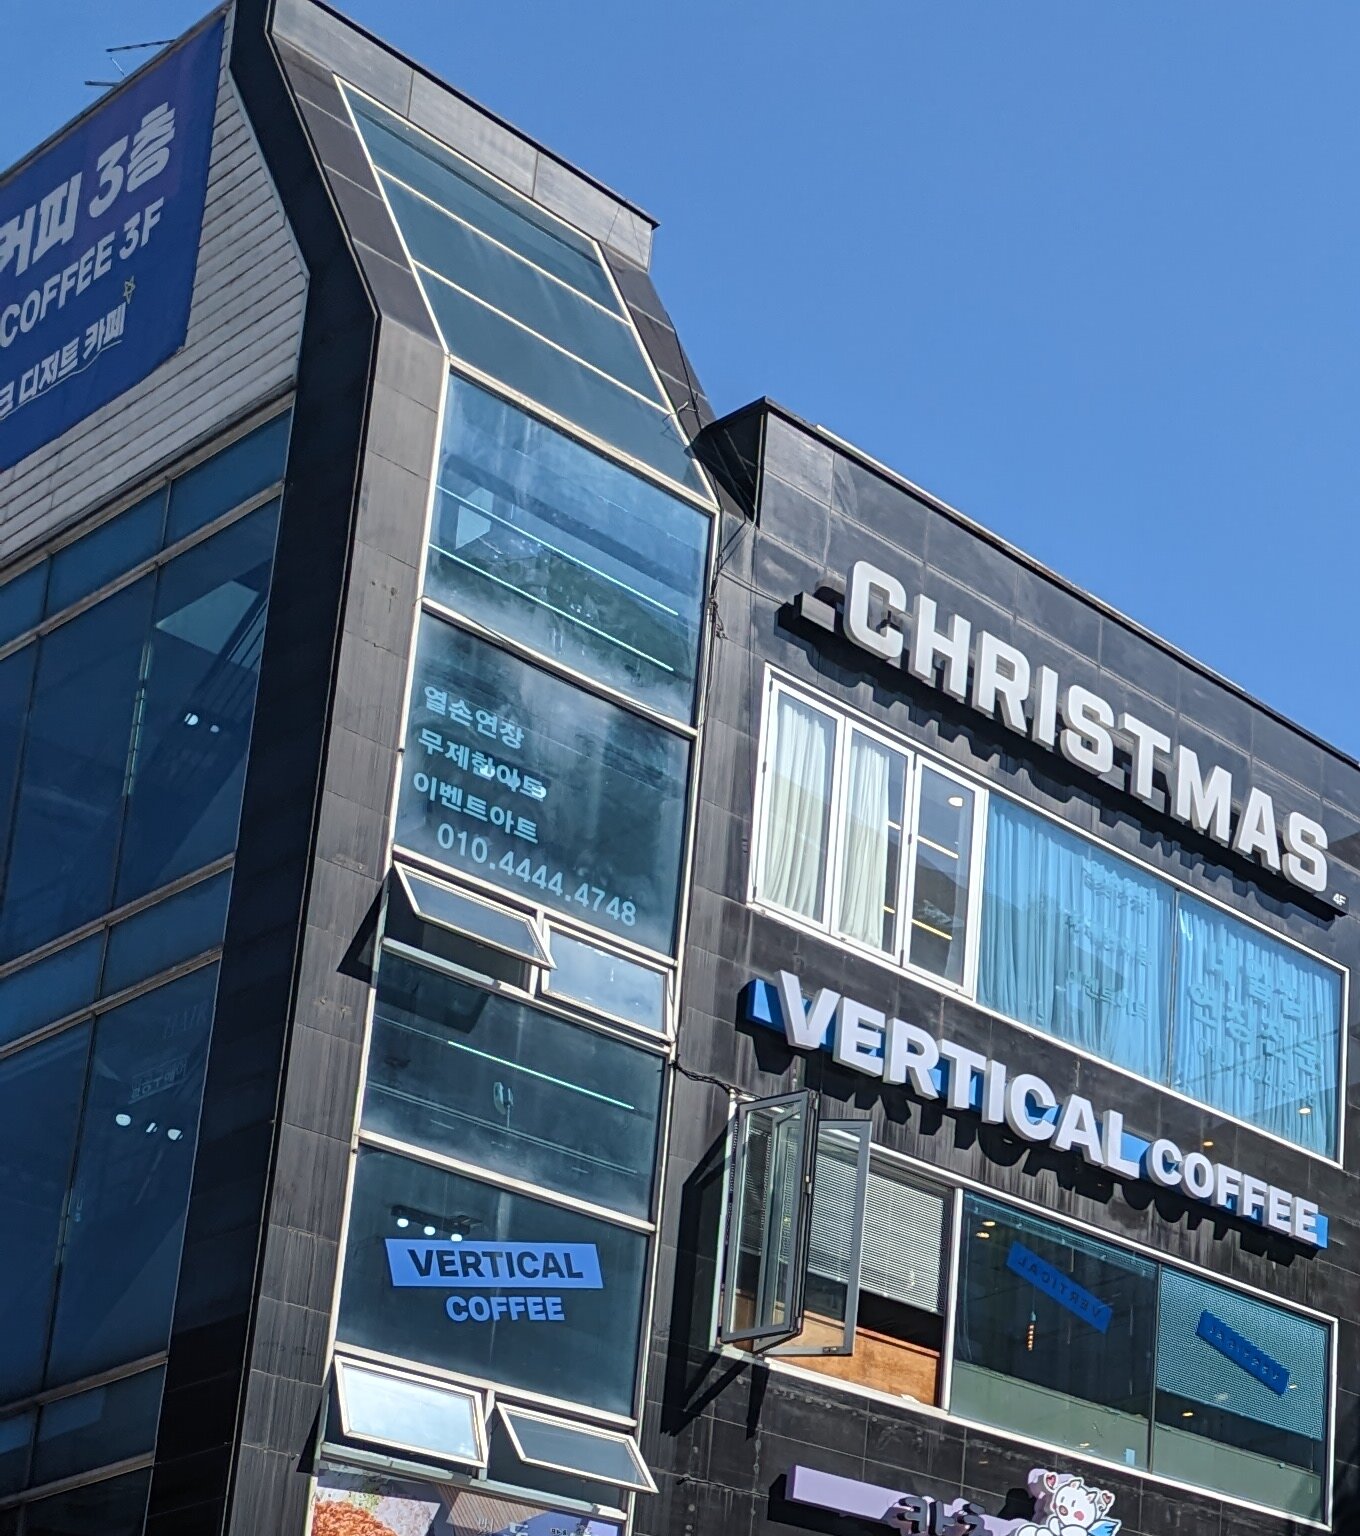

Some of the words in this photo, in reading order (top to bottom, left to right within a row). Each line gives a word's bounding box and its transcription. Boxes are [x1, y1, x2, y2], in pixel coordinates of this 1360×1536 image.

[89, 101, 176, 219] 3층
[1, 231, 116, 348] COFFEE
[120, 197, 164, 260] 3F
[19, 337, 80, 403] 디저트
[83, 302, 127, 360] 카페
[418, 728, 547, 802] 무제한아트
[424, 686, 525, 749] 열손연장
[843, 560, 1328, 895] CHRISTMAS
[413, 772, 539, 844] 이벤트아트
[437, 823, 637, 927] 010.4444.4748
[774, 970, 1141, 1180] VERTICAL
[1146, 1138, 1321, 1244] COFFEE
[407, 1247, 584, 1280] VERTICAL
[445, 1296, 565, 1323] COFFEE
